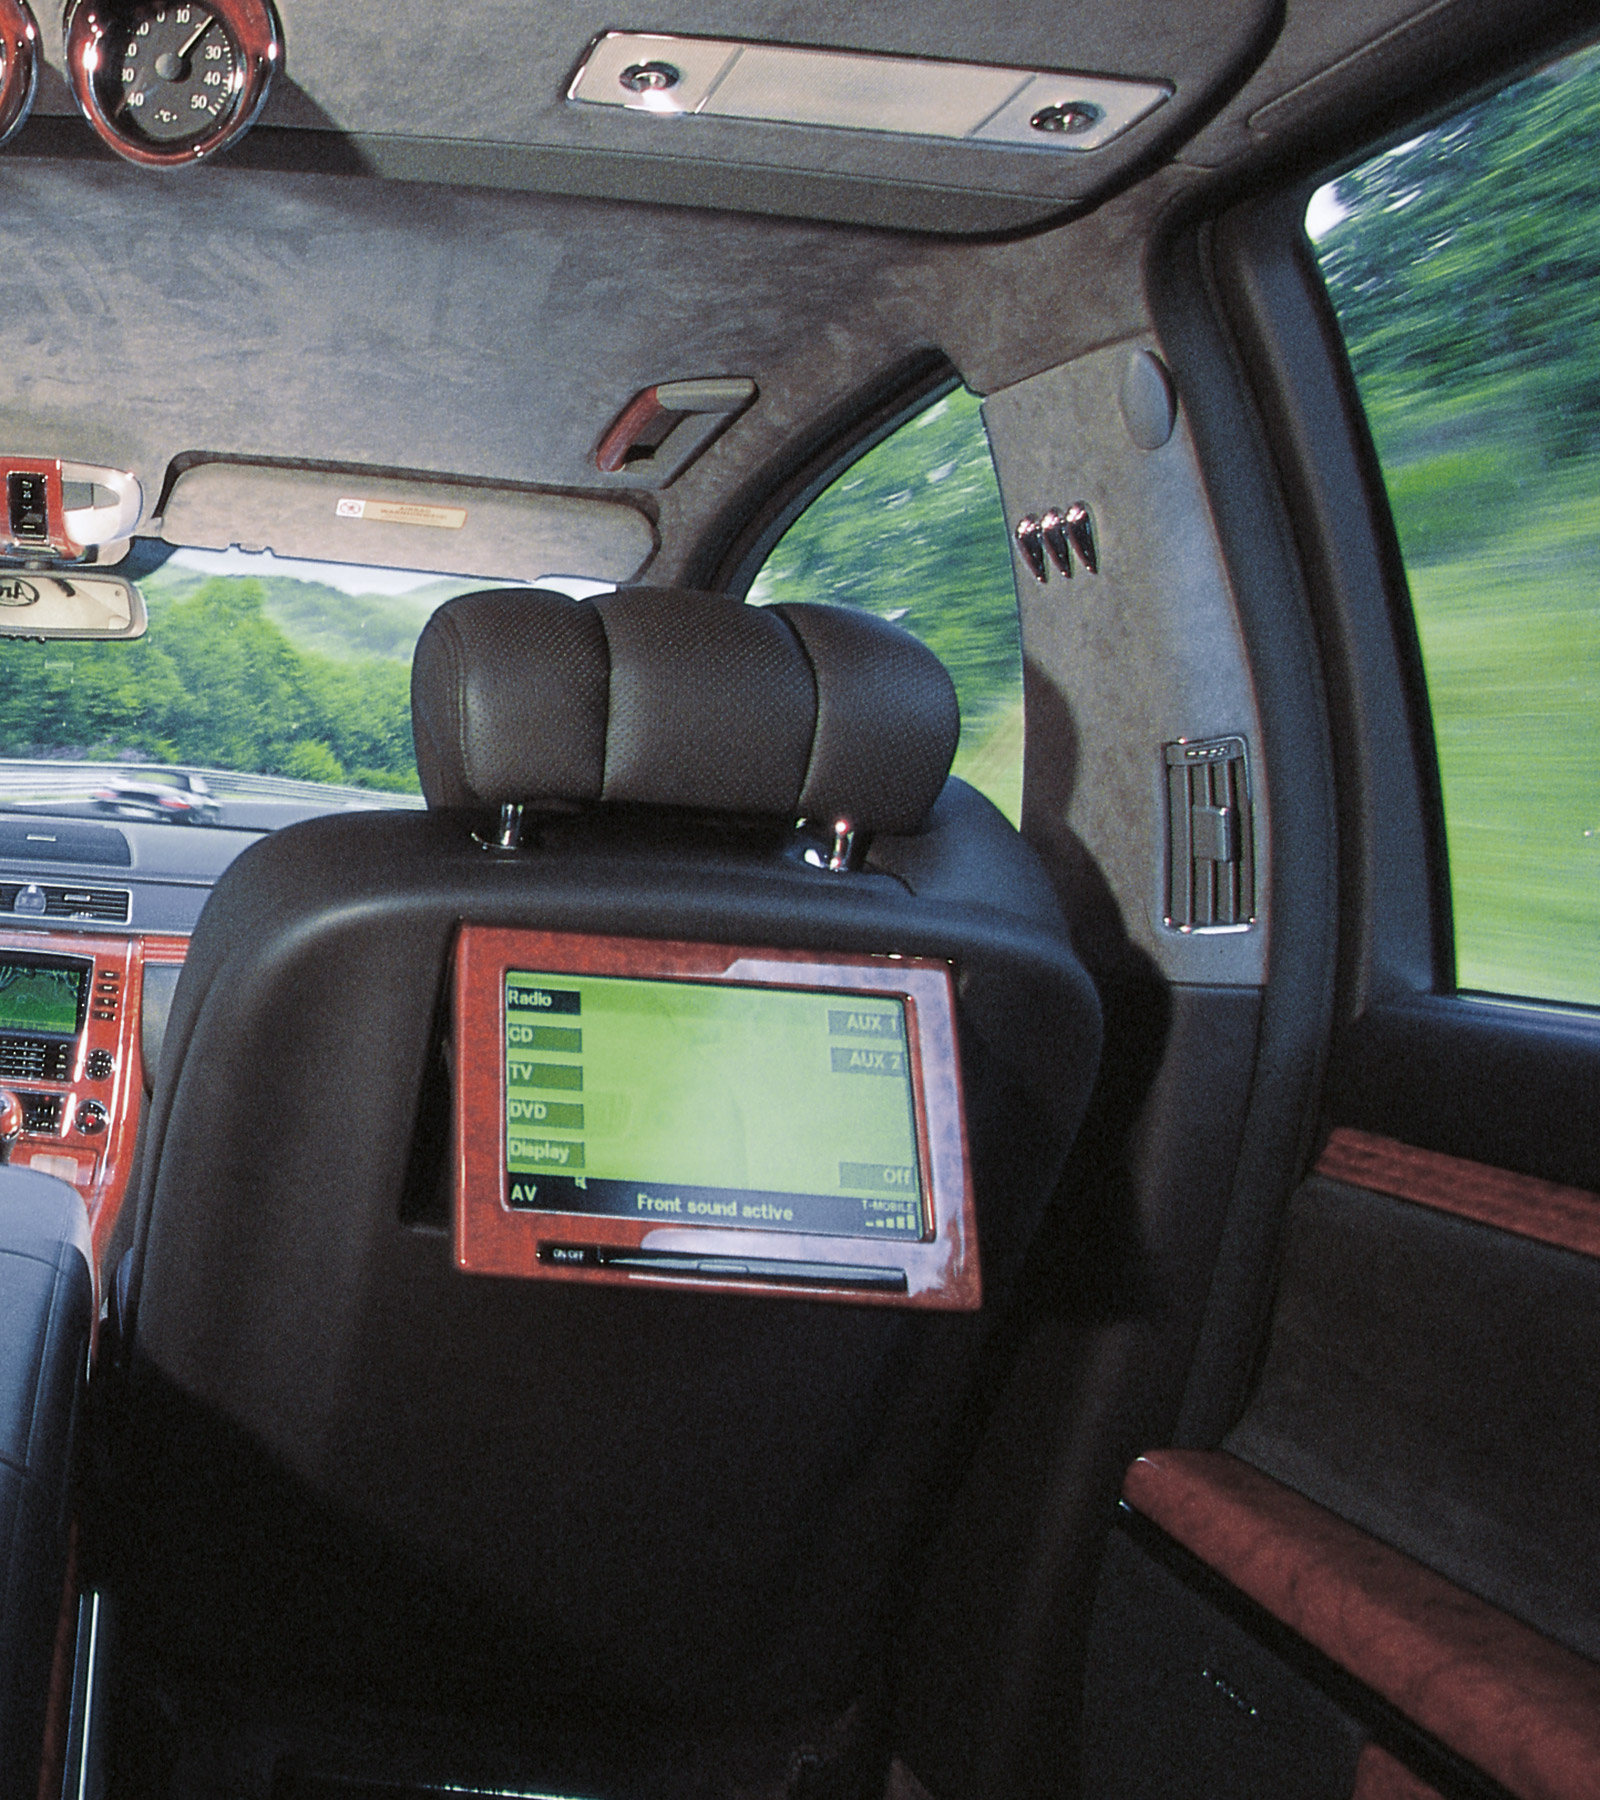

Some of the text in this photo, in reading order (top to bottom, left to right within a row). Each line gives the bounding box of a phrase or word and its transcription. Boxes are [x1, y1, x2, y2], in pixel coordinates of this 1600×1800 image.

[176, 9, 190, 23] 10
[205, 46, 221, 60] 30
[204, 71, 220, 86] 40
[191, 95, 207, 109] 50
[508, 989, 552, 1007] Radio
[847, 1013, 896, 1032] AUX 1
[509, 1027, 533, 1042] CD
[850, 1051, 900, 1070] AUX 2
[509, 1063, 532, 1081] TV
[509, 1102, 547, 1119] DVD
[510, 1140, 569, 1164] Display
[883, 1168, 911, 1184] Off
[511, 1184, 537, 1201] AV
[636, 1193, 793, 1221] Front sound active
[862, 1200, 914, 1213] T-MOBILE
